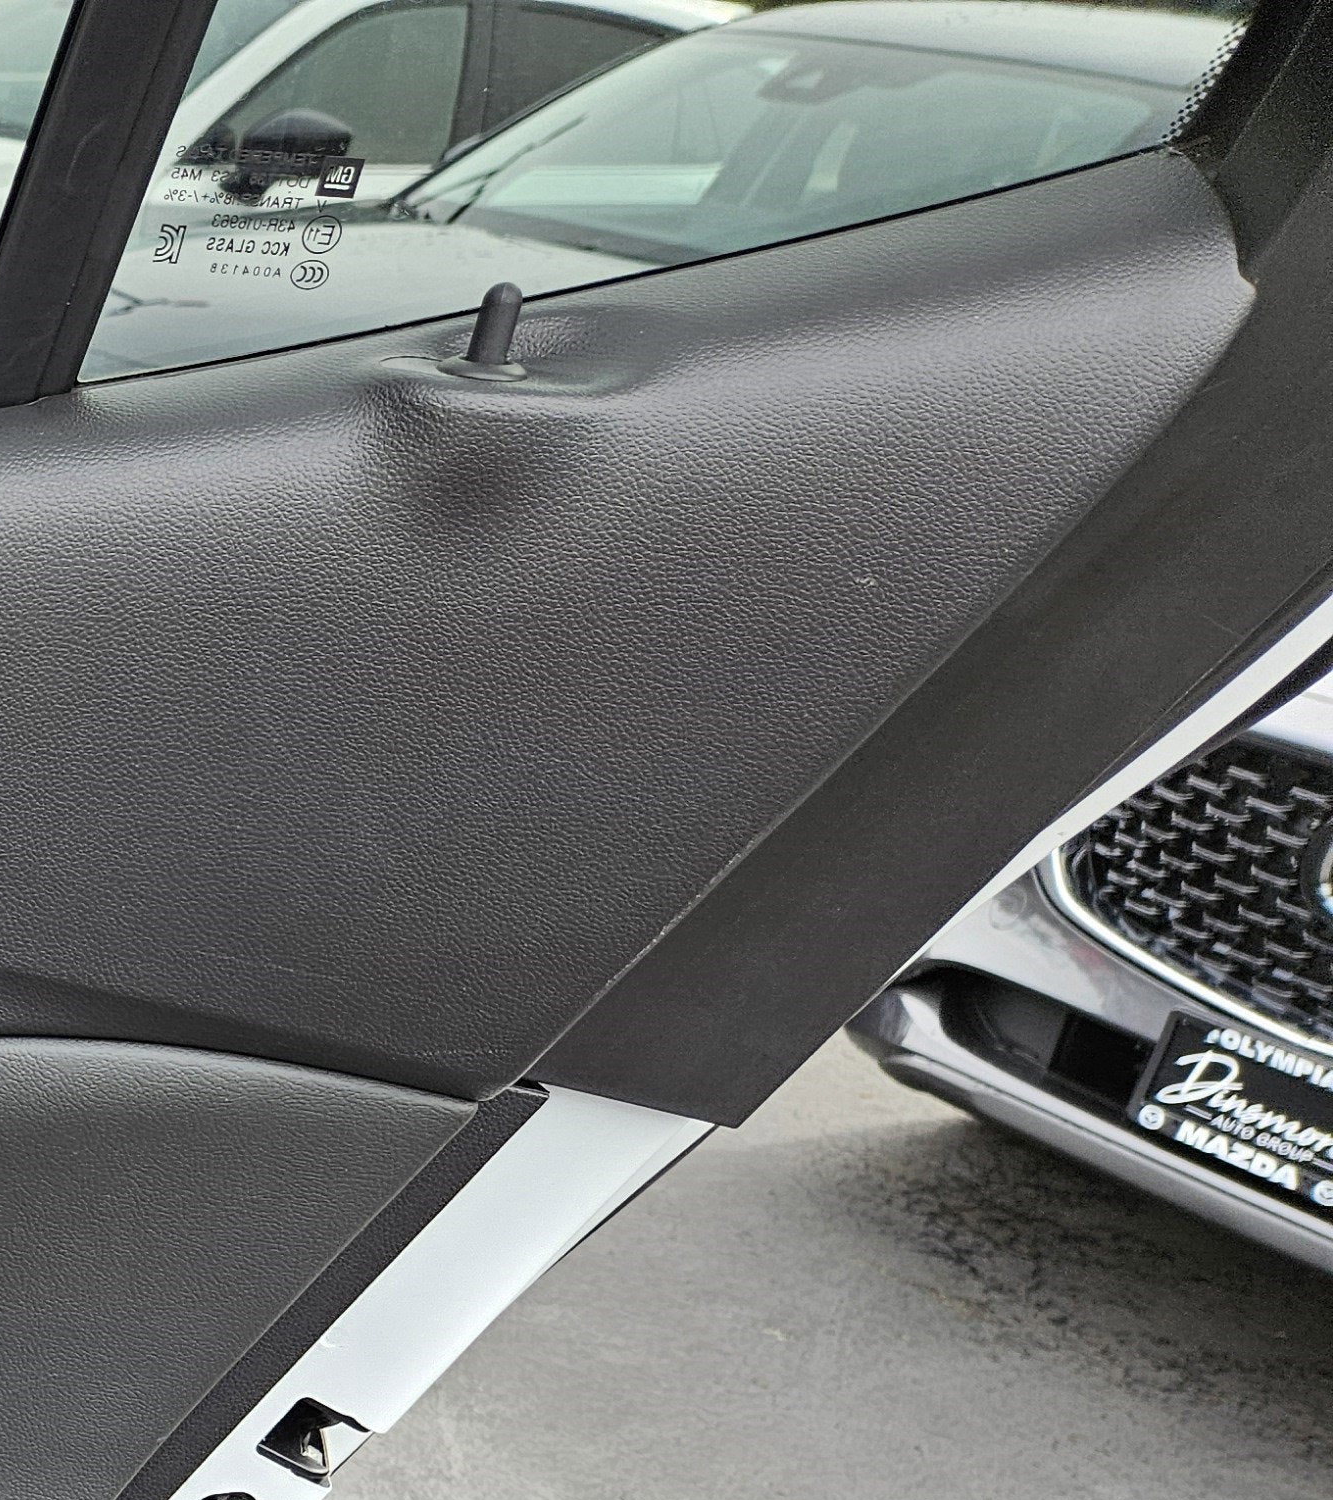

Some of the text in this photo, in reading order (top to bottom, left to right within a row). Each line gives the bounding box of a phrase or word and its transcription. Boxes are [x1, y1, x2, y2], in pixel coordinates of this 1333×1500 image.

[1175, 1120, 1300, 1190] MAZDA
[1210, 1114, 1315, 1163] AUTO GROUP
